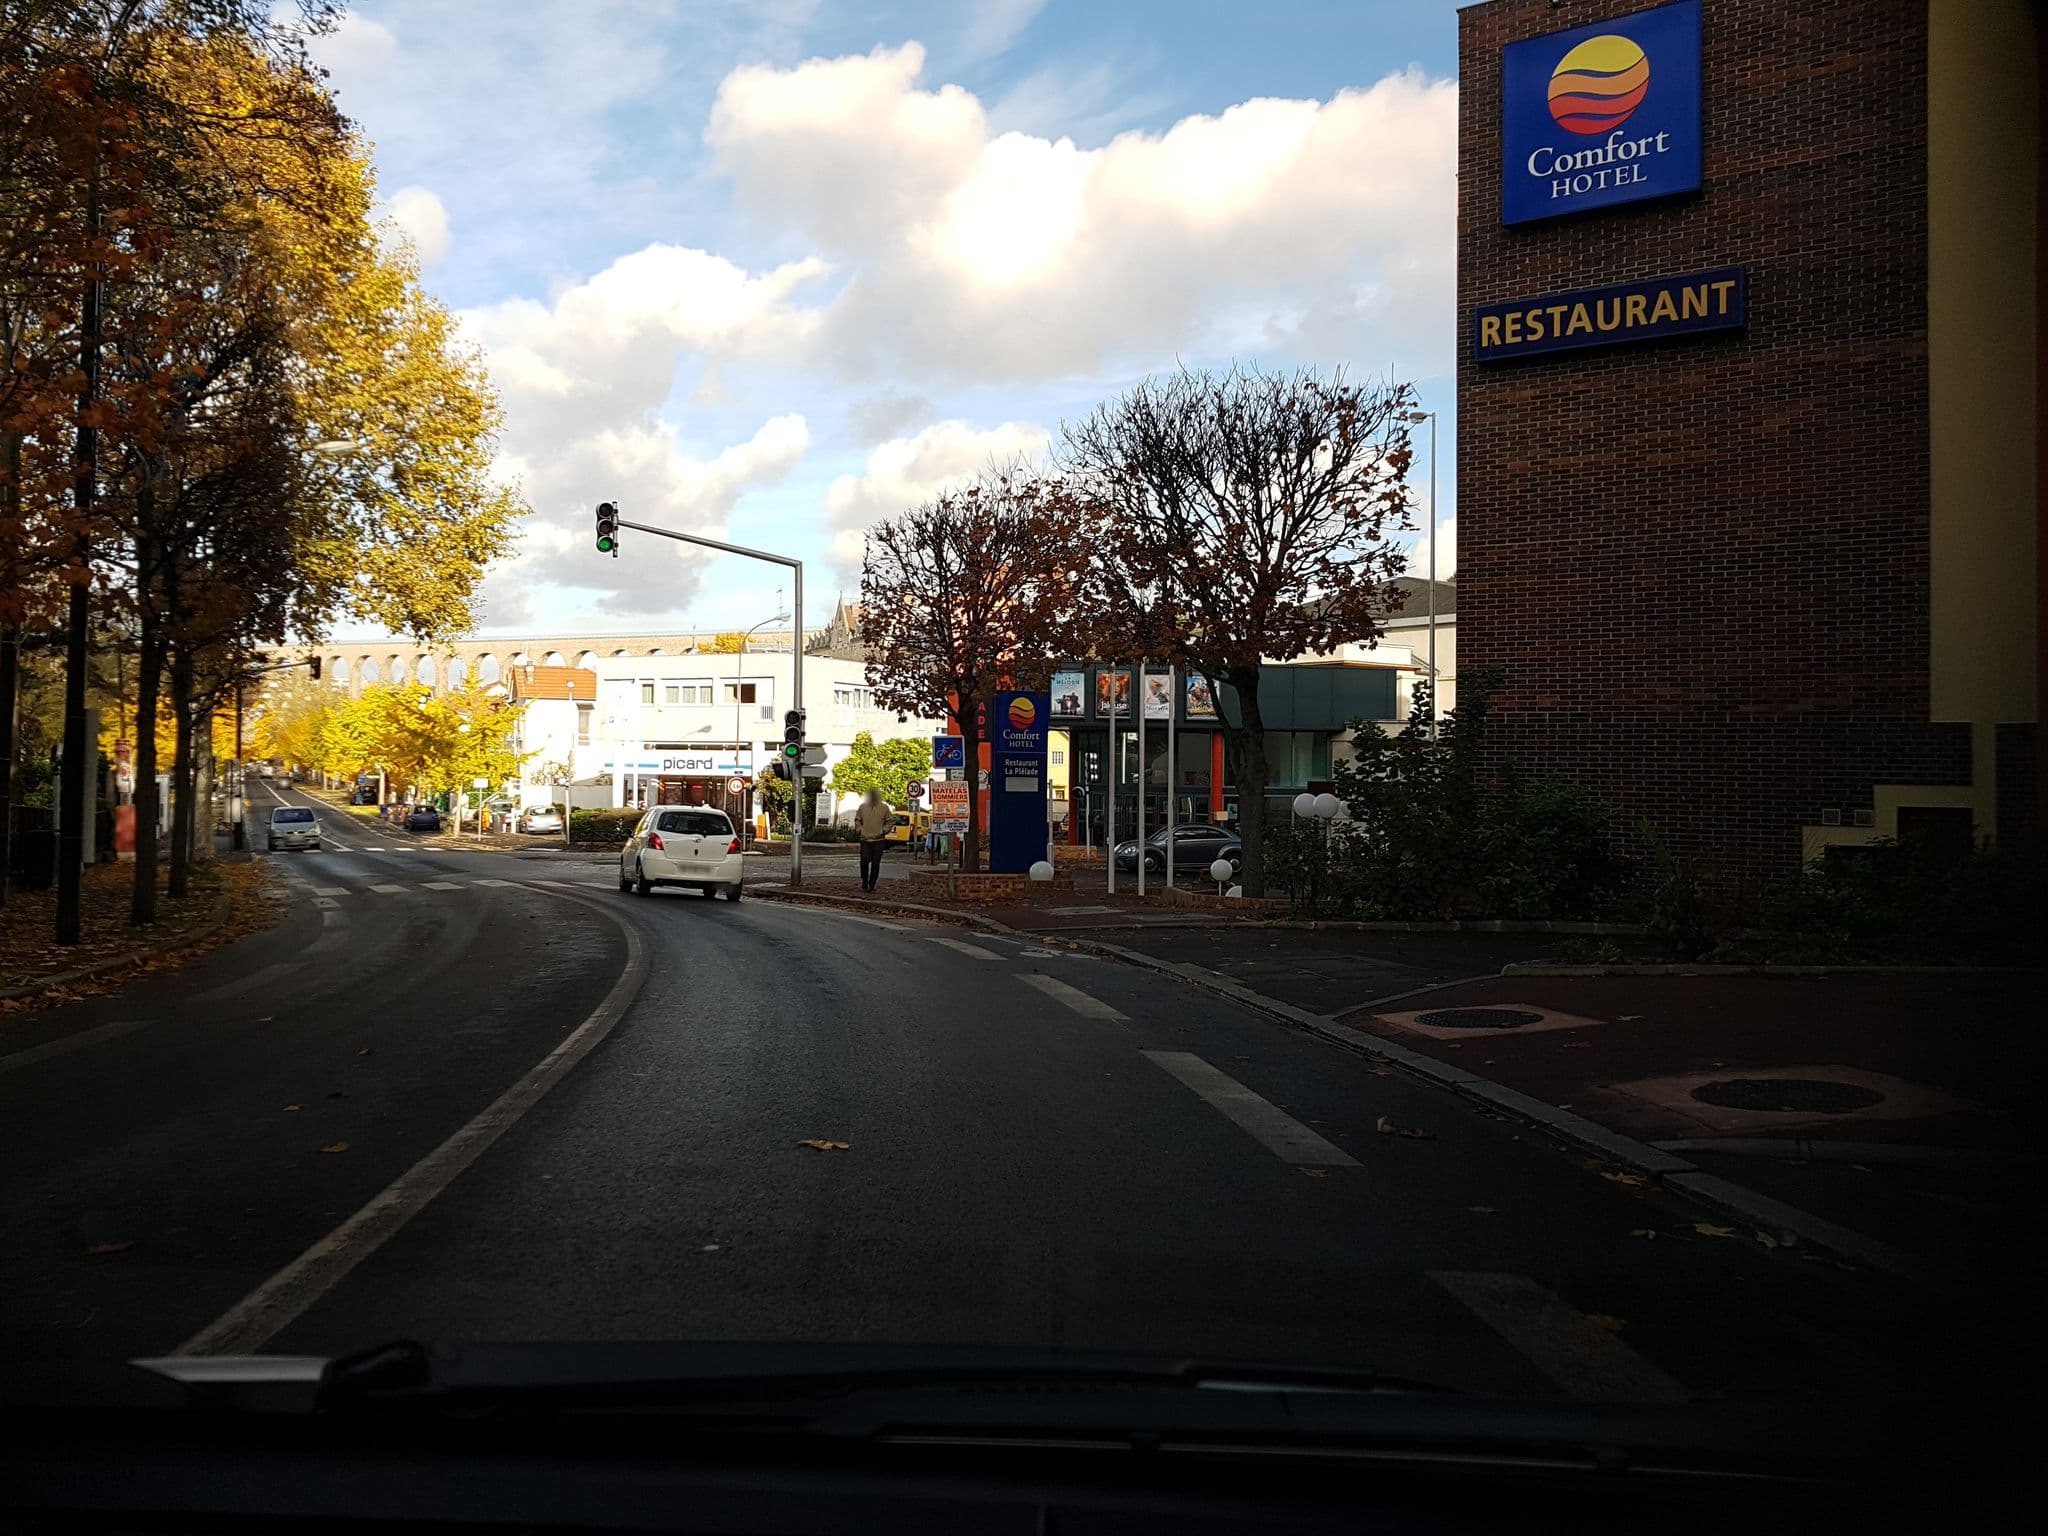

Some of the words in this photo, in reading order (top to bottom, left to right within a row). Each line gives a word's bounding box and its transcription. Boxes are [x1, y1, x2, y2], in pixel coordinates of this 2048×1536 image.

[1527, 130, 1670, 177] Comfort
[1550, 163, 1647, 199] HOTEL
[1481, 280, 1736, 347] RESTAURANT
[1101, 701, 1127, 711] Jaluse
[1002, 728, 1041, 740] Comfort
[1009, 740, 1034, 748] HOTEL
[663, 757, 713, 771] picard
[1005, 759, 1039, 767] Restaurant
[1005, 767, 1013, 775] La
[909, 785, 918, 793] 30
